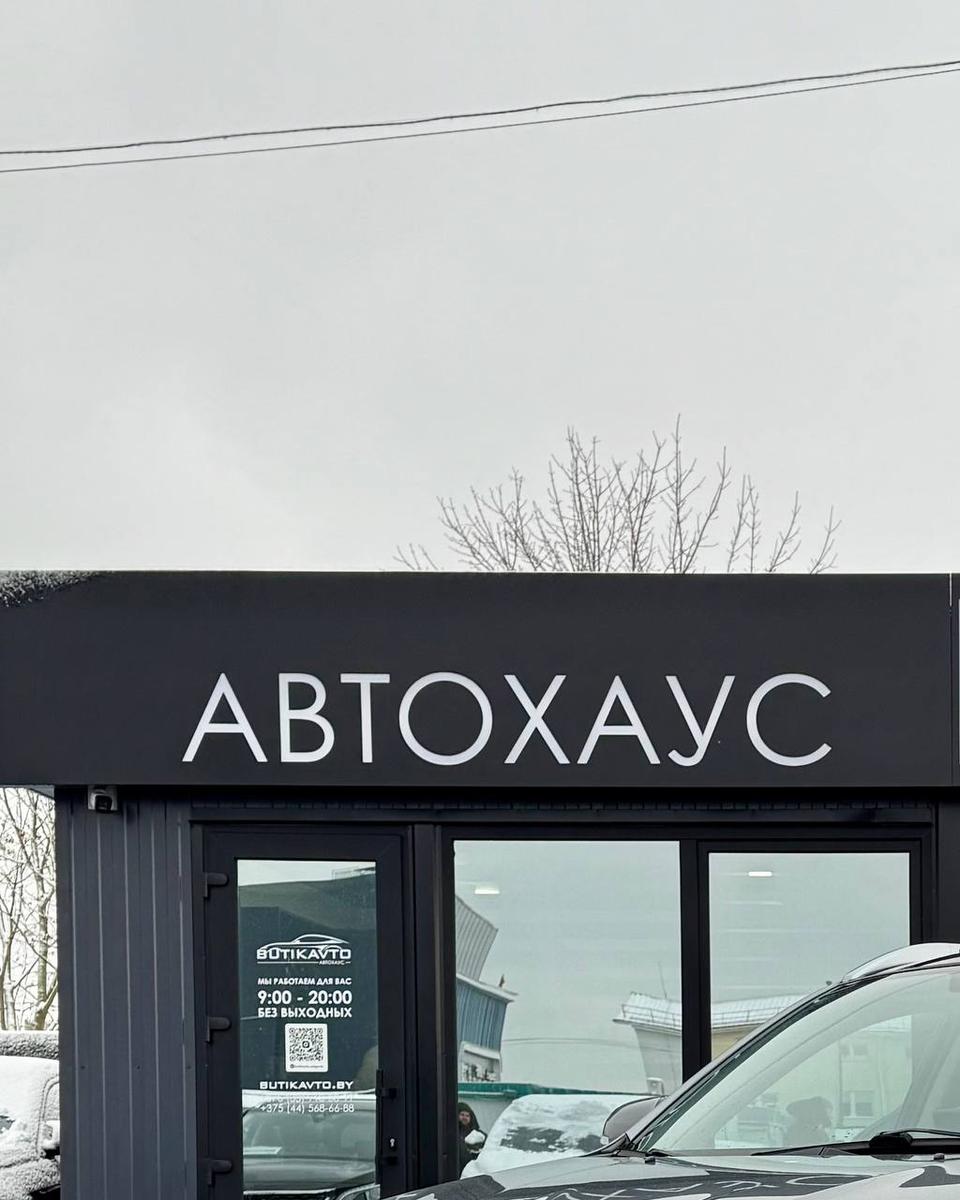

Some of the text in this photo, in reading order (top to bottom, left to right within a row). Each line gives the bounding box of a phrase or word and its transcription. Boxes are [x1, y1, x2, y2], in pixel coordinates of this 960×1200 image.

[182, 671, 833, 767] АВТОХАУС
[256, 948, 352, 960] BUTIKAVTO
[257, 978, 352, 986] МЫ РАБОТАЕМ ДЛЯ ВАС
[257, 990, 293, 1005] 9:00
[308, 990, 353, 1005] 20:00
[257, 1007, 353, 1020] БЕЗ ВЫХОДНЫХ
[260, 1081, 354, 1090] BUTIKAVTO.BY
[260, 1102, 355, 1115] +375 (44) 568-66-88
